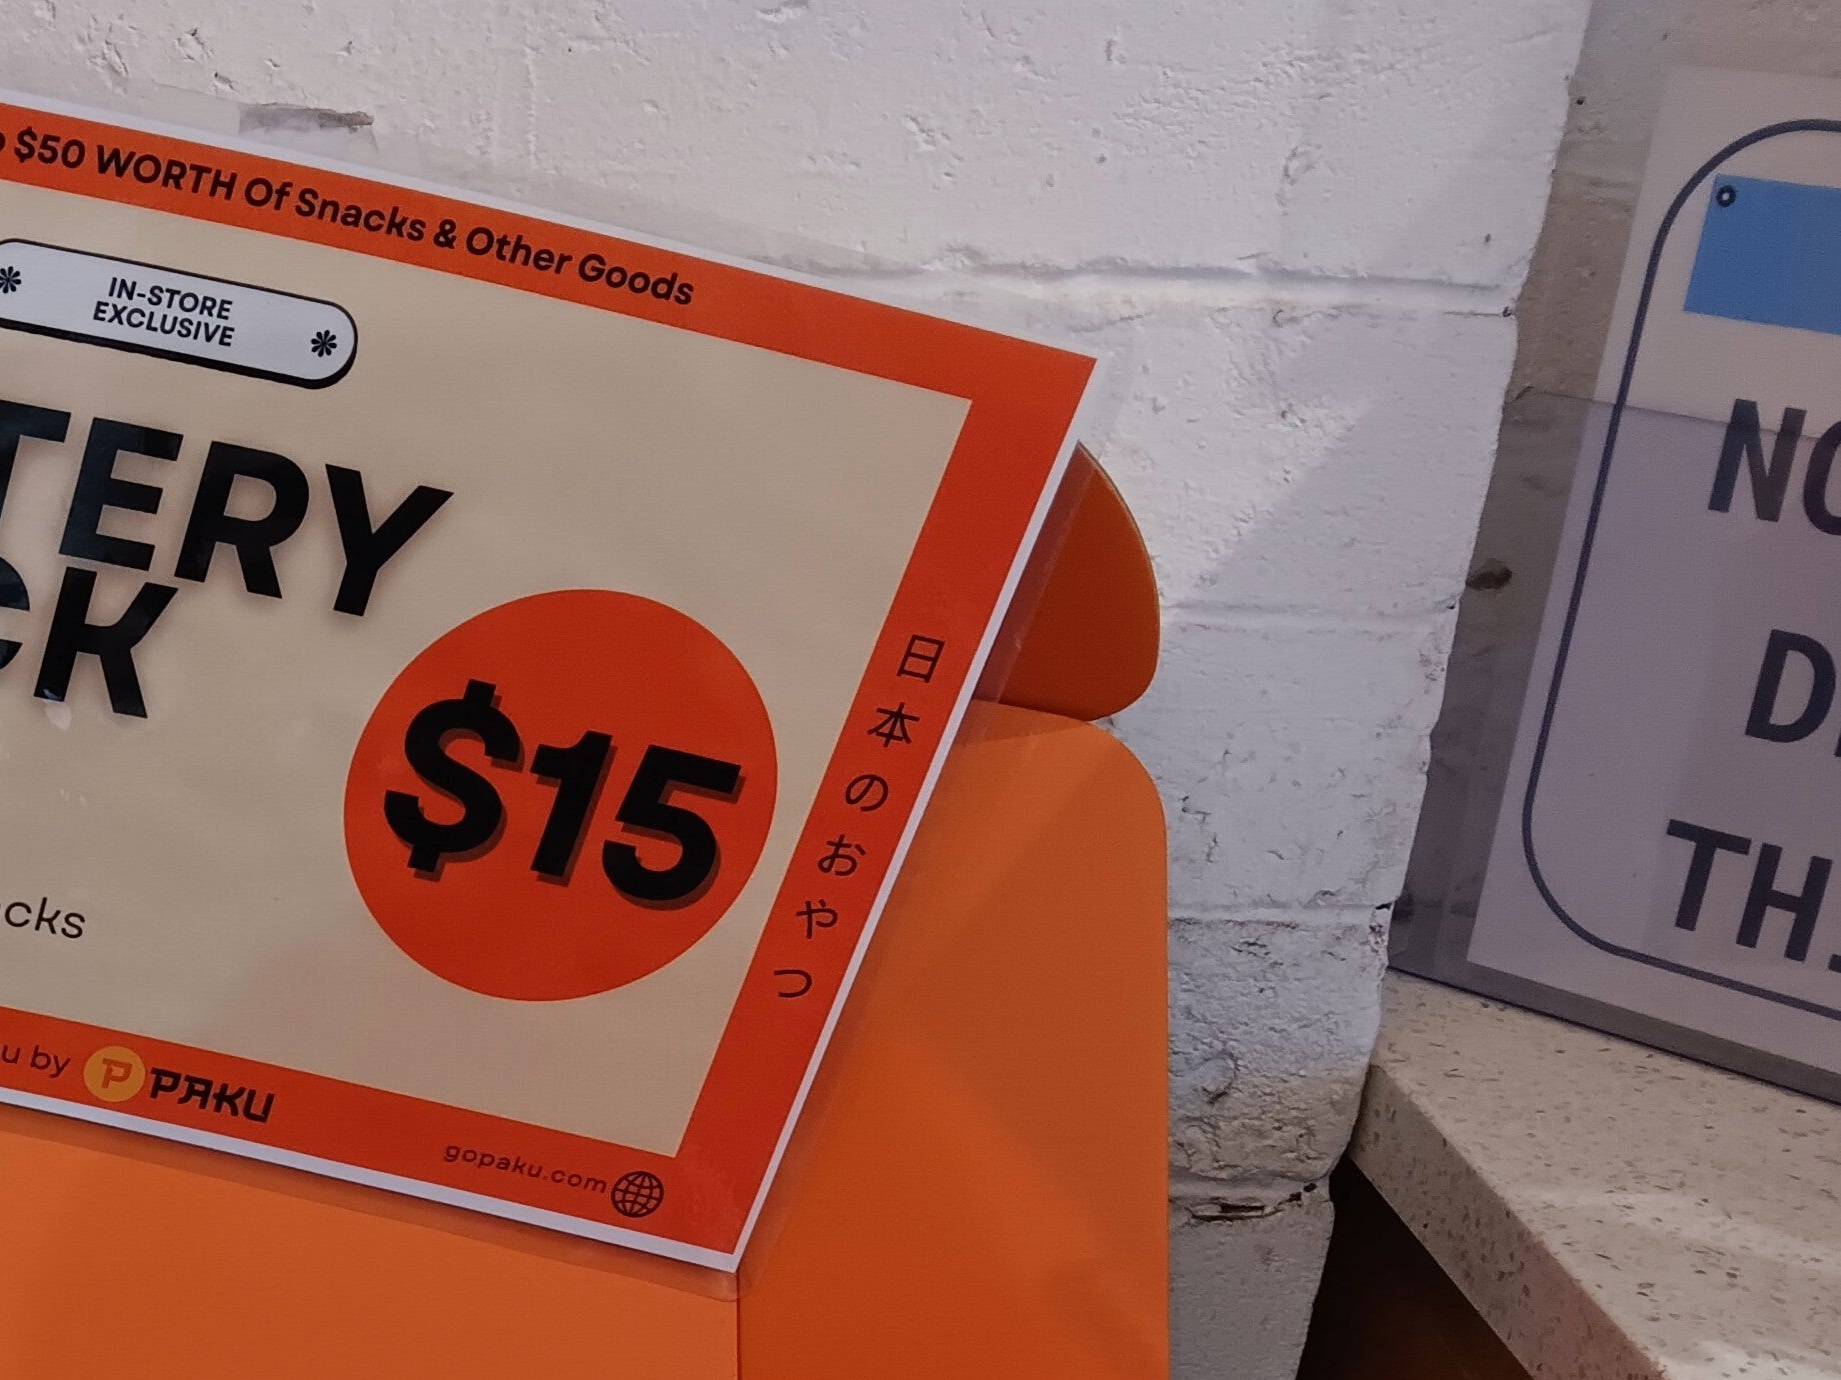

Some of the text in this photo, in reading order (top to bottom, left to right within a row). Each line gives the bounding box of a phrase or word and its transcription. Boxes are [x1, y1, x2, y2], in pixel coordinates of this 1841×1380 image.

[14, 127, 86, 169] $50
[96, 146, 238, 201] WORTH
[244, 177, 293, 210] Of
[295, 187, 427, 243] Snacks
[434, 218, 457, 249] &
[465, 225, 572, 274] Other
[578, 253, 695, 306] Goods
[93, 301, 235, 347] EXCLUSIVE
[108, 276, 233, 321] IN-STORE
[383, 678, 744, 908] $15
[773, 634, 946, 998] 日本のおやつ
[29, 1038, 72, 1080] by
[149, 1066, 276, 1125] PAKU
[442, 1141, 609, 1197] gopaku.com
